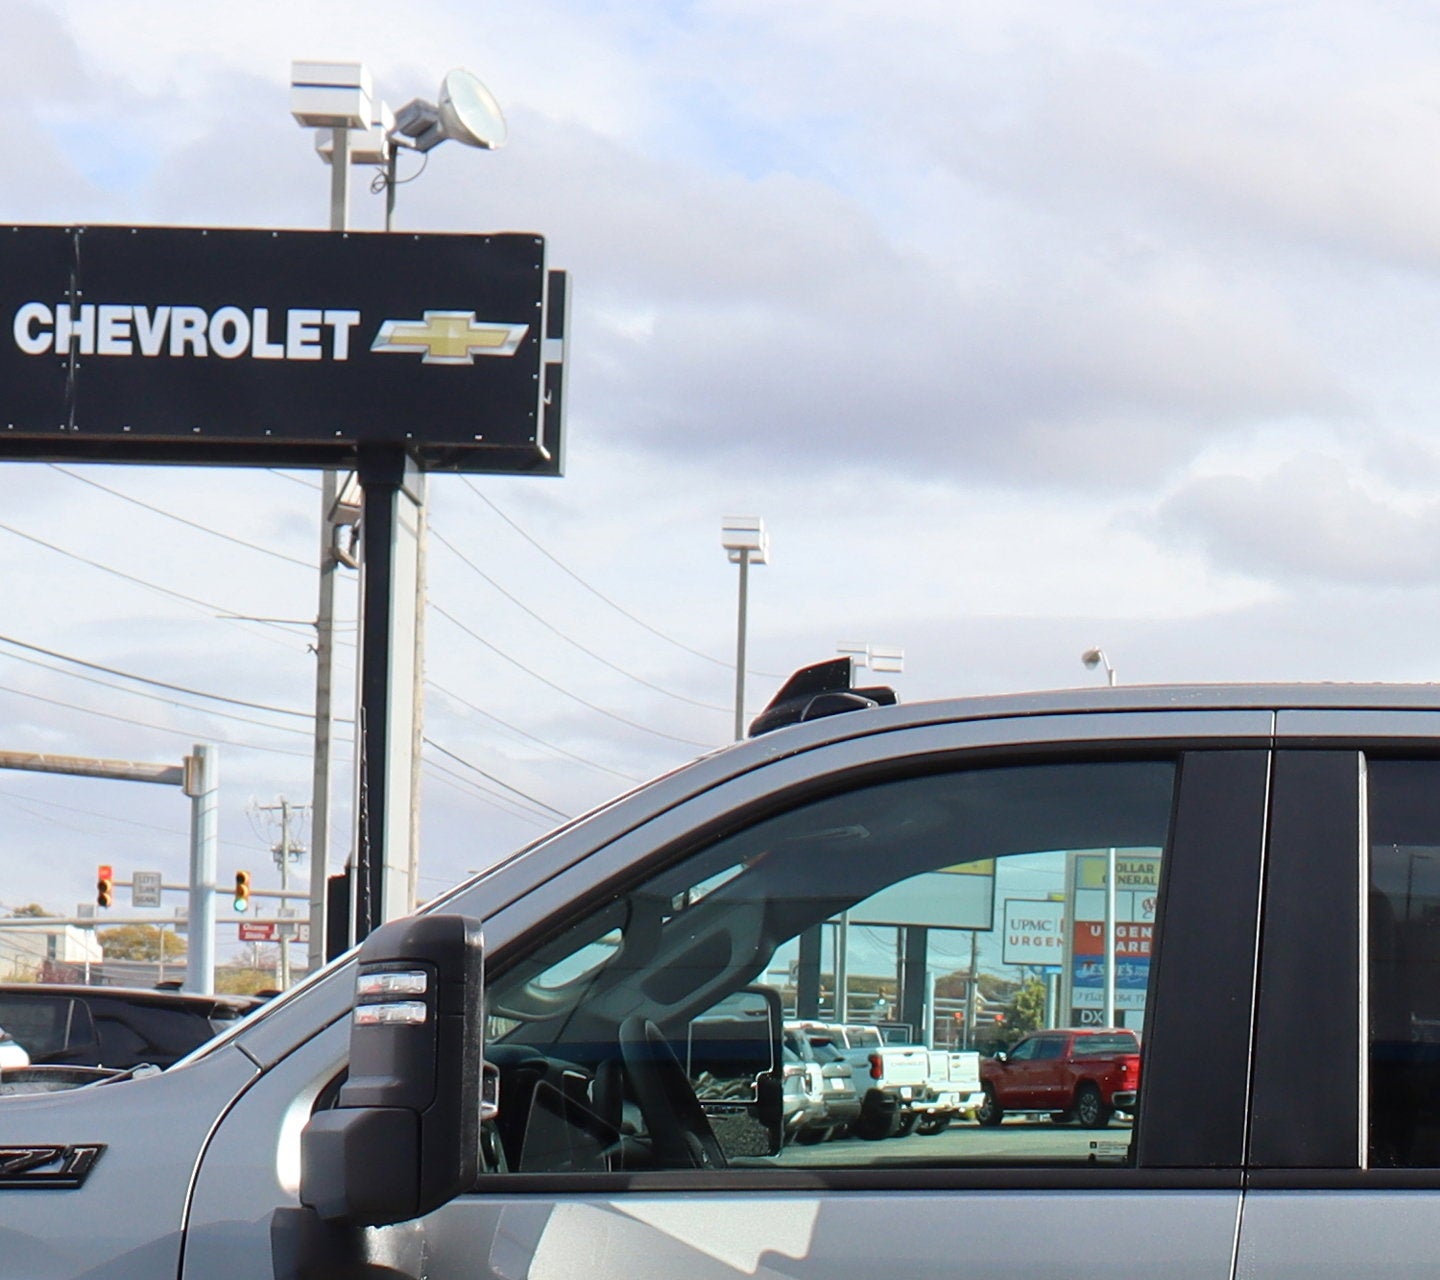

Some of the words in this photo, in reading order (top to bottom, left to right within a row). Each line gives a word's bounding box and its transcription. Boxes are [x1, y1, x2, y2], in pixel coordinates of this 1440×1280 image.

[13, 302, 361, 361] CHEVROLET
[1116, 862, 1155, 874] OLLAR
[1102, 874, 1158, 886] NERAL
[1010, 918, 1053, 931] UPMC
[1090, 925, 1153, 938] UGEN
[1010, 935, 1064, 947] URGEN
[1115, 941, 1151, 953] ARE
[1080, 1010, 1104, 1023] DX
